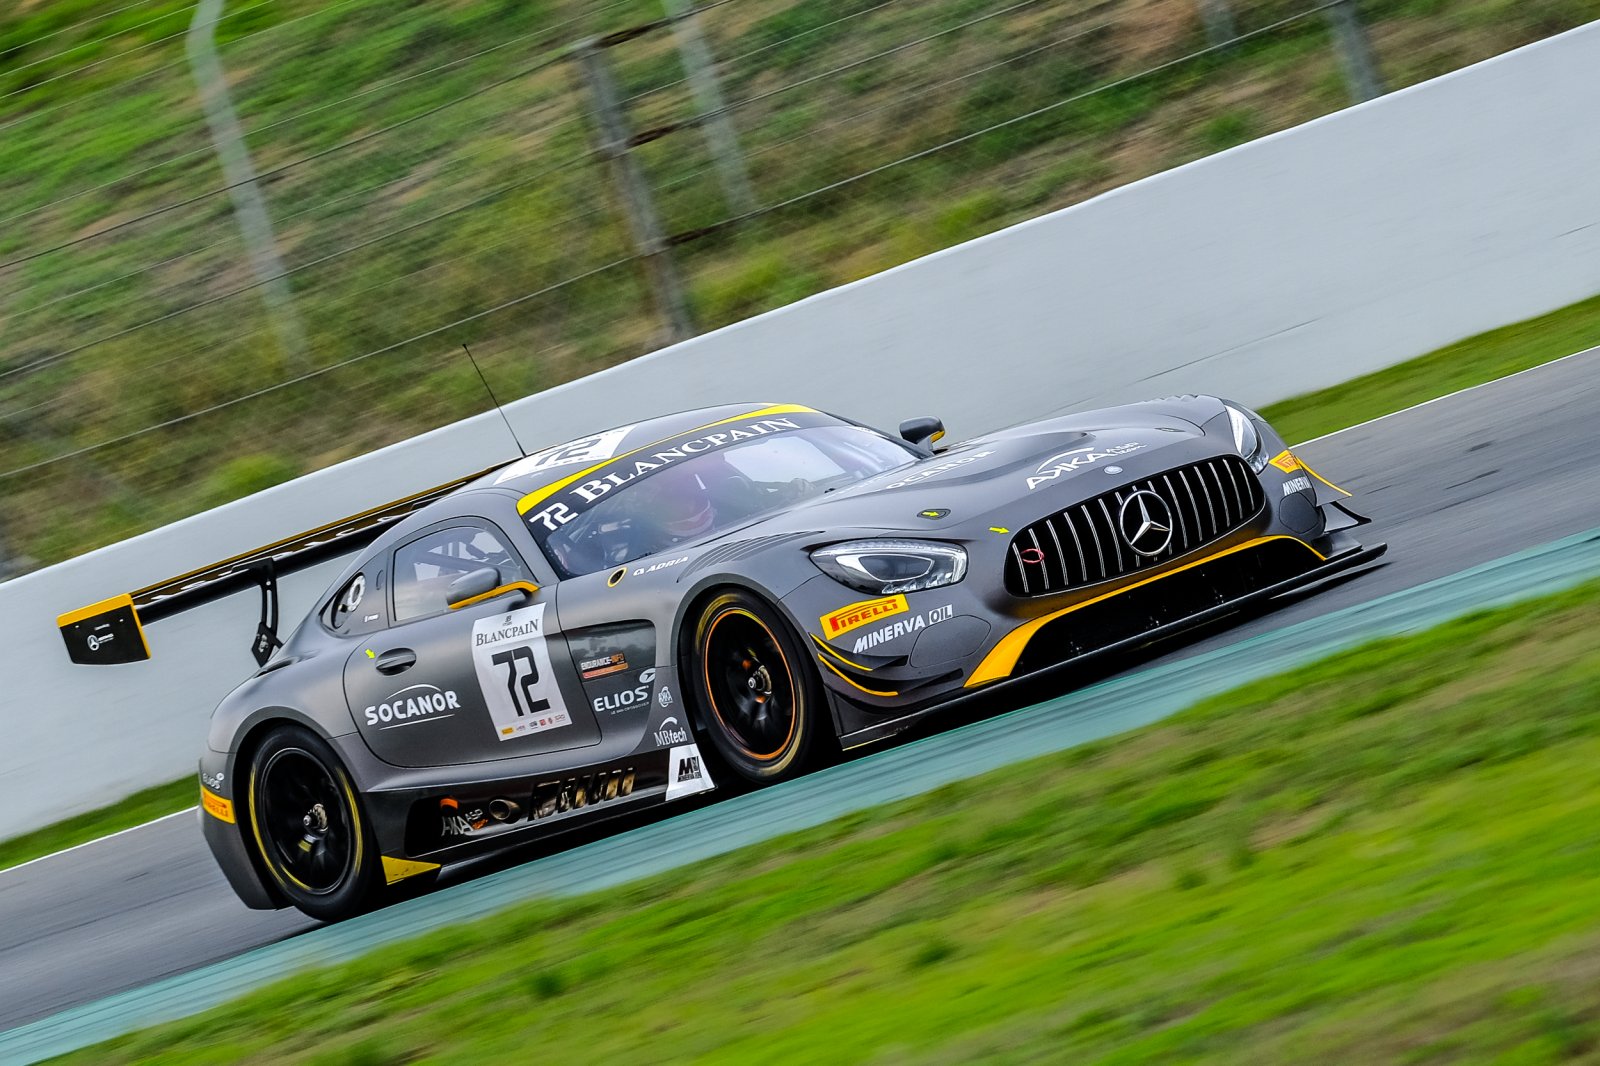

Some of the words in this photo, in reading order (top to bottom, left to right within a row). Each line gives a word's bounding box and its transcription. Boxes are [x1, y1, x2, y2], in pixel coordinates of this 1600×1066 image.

[535, 439, 602, 467] 72
[569, 417, 801, 504] BLANCPAIN
[529, 501, 579, 531] 72
[829, 598, 899, 632] PIRELLI
[853, 615, 926, 654] MINERVA
[929, 604, 953, 625] OIL
[475, 618, 539, 647] BLANCPAIN
[491, 645, 551, 717] 72
[364, 690, 462, 726] SOCANOR
[593, 685, 648, 712] ELIOS
[653, 727, 688, 747] MBtech
